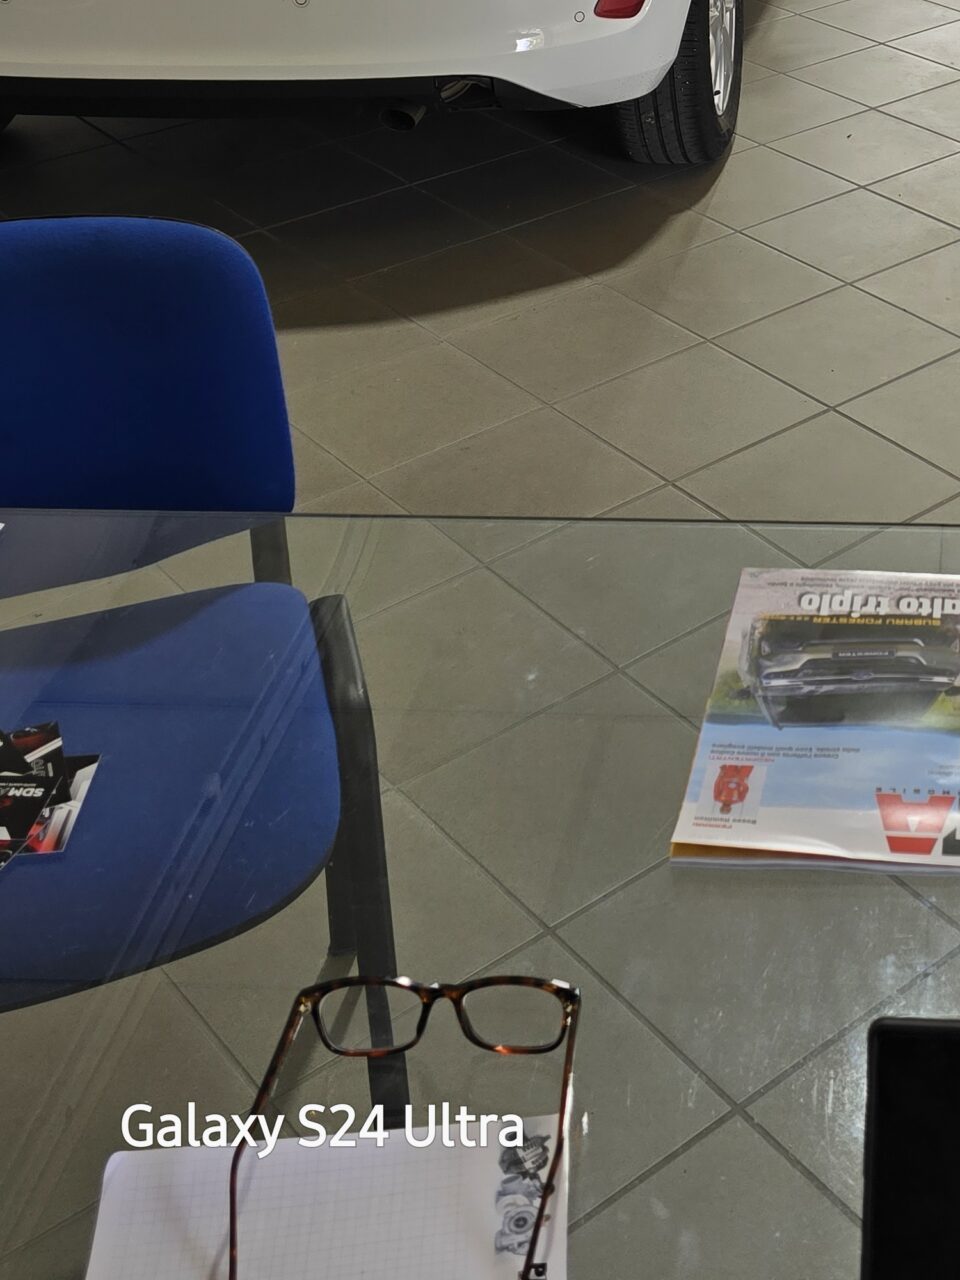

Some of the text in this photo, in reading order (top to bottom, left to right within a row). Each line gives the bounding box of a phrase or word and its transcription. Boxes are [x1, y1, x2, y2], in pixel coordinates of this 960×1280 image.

[800, 590, 890, 618] triplo
[812, 616, 882, 624] FORESTER
[886, 618, 941, 626] SUBARU
